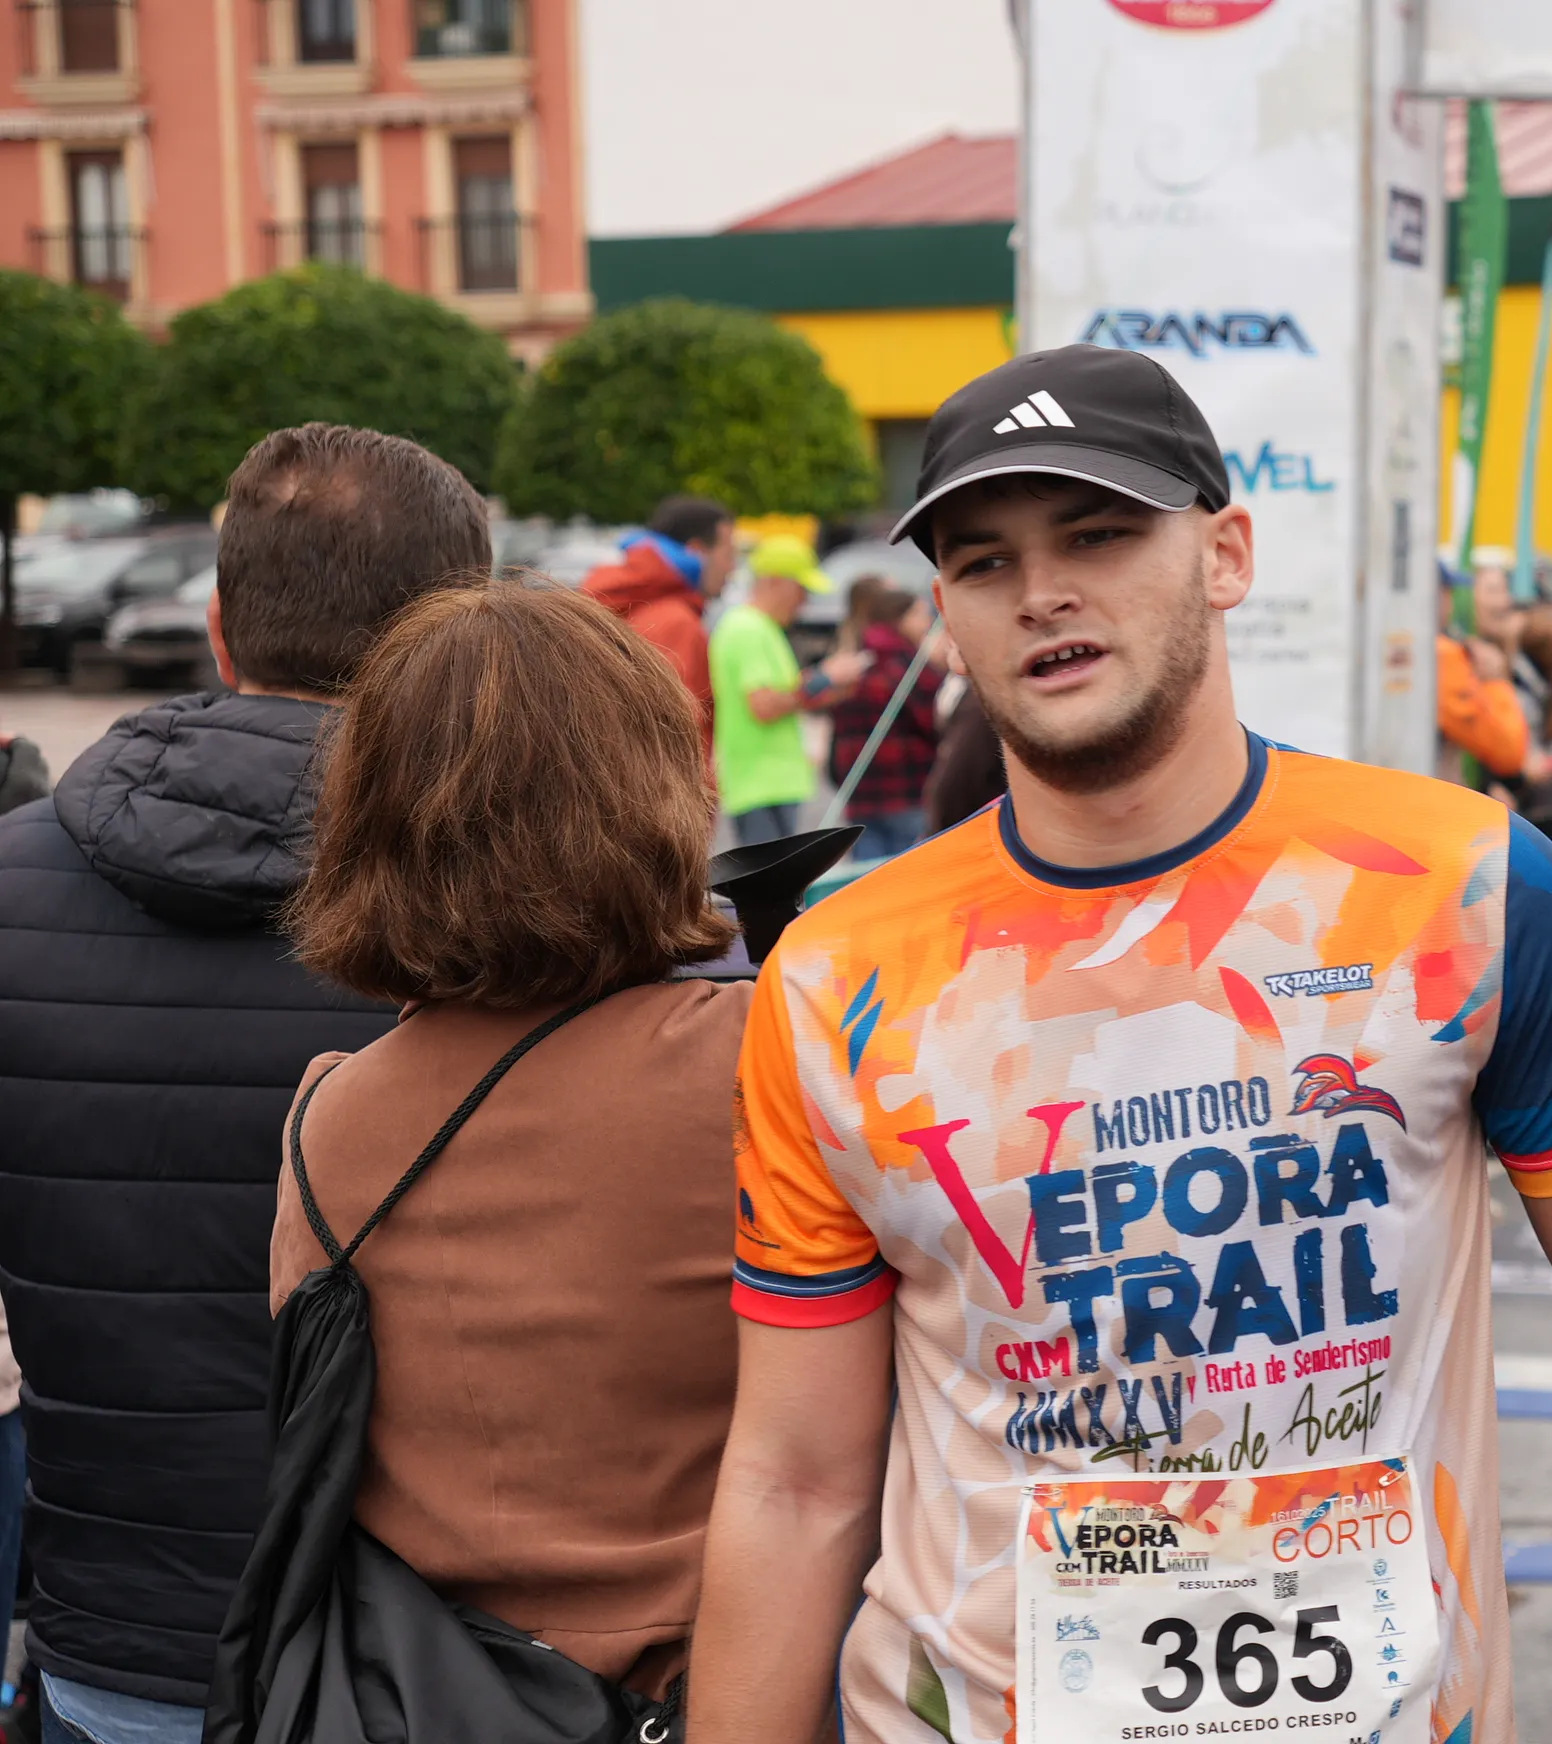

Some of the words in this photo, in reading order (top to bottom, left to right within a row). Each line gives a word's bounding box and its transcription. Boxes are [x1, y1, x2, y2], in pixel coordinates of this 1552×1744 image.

[1079, 310, 1316, 358] ARANDA
[1223, 442, 1335, 494] VEL
[1291, 963, 1373, 989] TAKELOT
[1093, 1076, 1271, 1153] MONTORO
[898, 1101, 1086, 1310] V
[1026, 1122, 1390, 1265] EPORA
[1042, 1223, 1399, 1374] TRAIL
[996, 1336, 1072, 1383] CXM
[1206, 1362, 1257, 1393] Ruta
[1265, 1353, 1287, 1385] de
[1294, 1334, 1392, 1378] Senderismo
[1006, 1371, 1184, 1455] MMXXV
[1090, 1427, 1223, 1474] Tierra
[1228, 1401, 1270, 1471] de
[1275, 1360, 1387, 1457] Aceite
[1324, 1489, 1394, 1519] TRAIL
[1044, 1505, 1094, 1560] V
[1076, 1523, 1179, 1550] EPORA
[1272, 1509, 1413, 1563] CORTO
[1055, 1562, 1081, 1573] CXM
[1080, 1550, 1167, 1575] TRAIL
[1178, 1577, 1258, 1590] RESULTADOS
[1141, 1604, 1353, 1714] 365
[1121, 1723, 1189, 1740] SERGIO
[1195, 1717, 1279, 1735] SALCEDO
[1286, 1711, 1357, 1728] CRESPO
